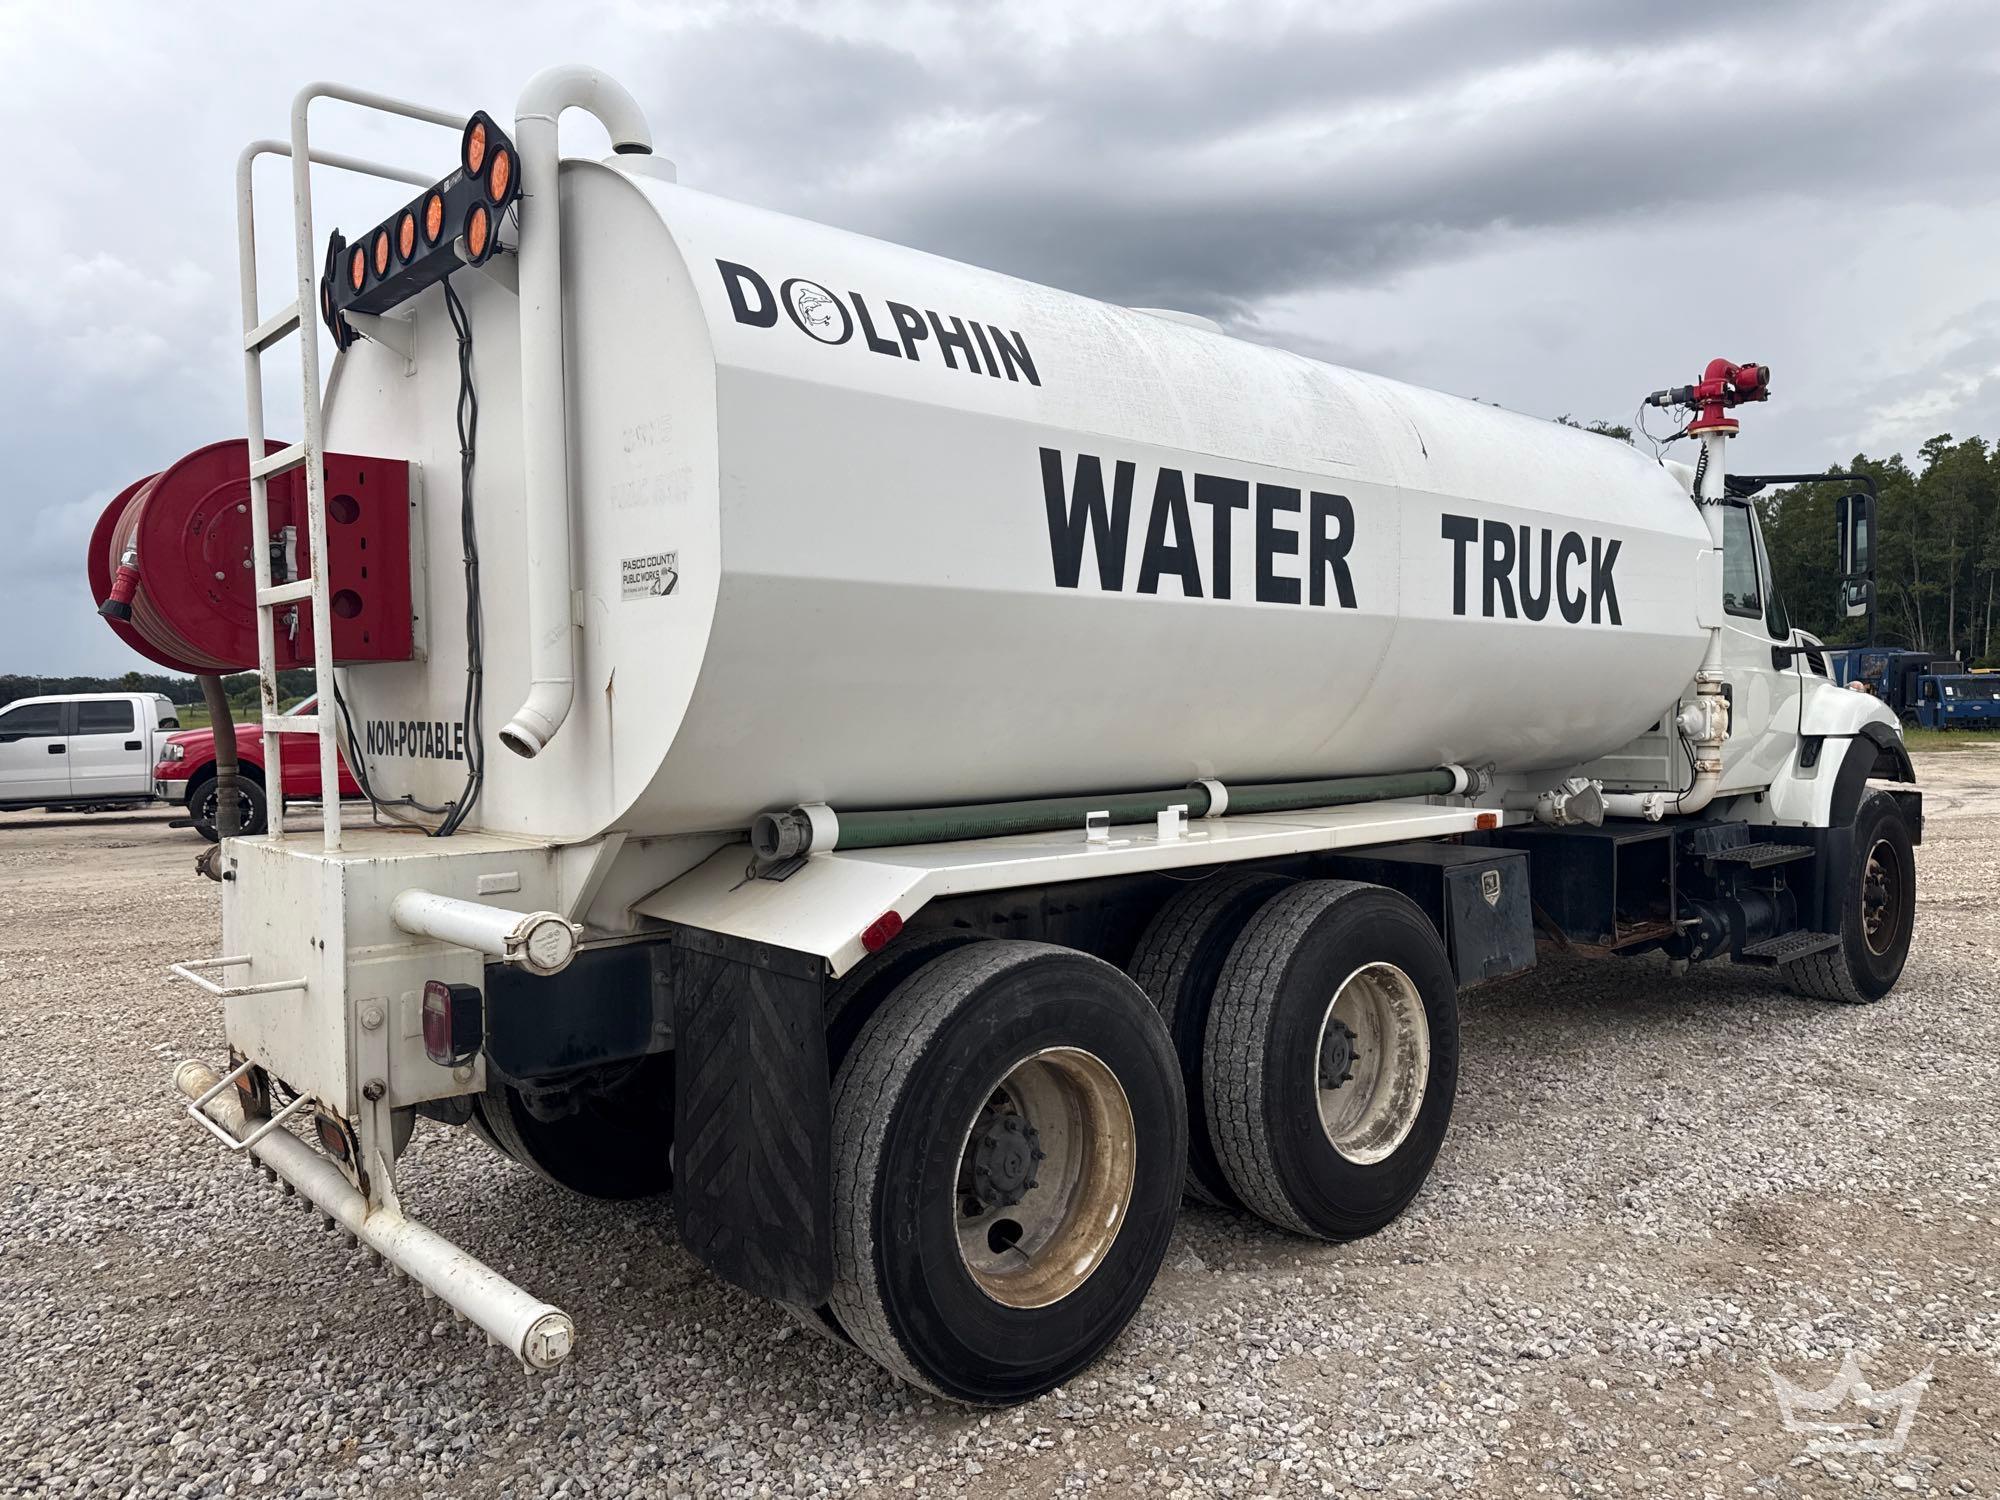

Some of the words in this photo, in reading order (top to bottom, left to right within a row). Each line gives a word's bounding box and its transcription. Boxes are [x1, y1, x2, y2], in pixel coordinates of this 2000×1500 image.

[715, 258, 1041, 387] DOLPHIN
[1039, 447, 1358, 609] WATER
[1441, 513, 1623, 626] TRUCK
[622, 559, 646, 571] PASCO
[647, 552, 676, 567] COUNTY
[641, 570, 660, 582] WORKS
[366, 720, 464, 760] NON-POTABLE
